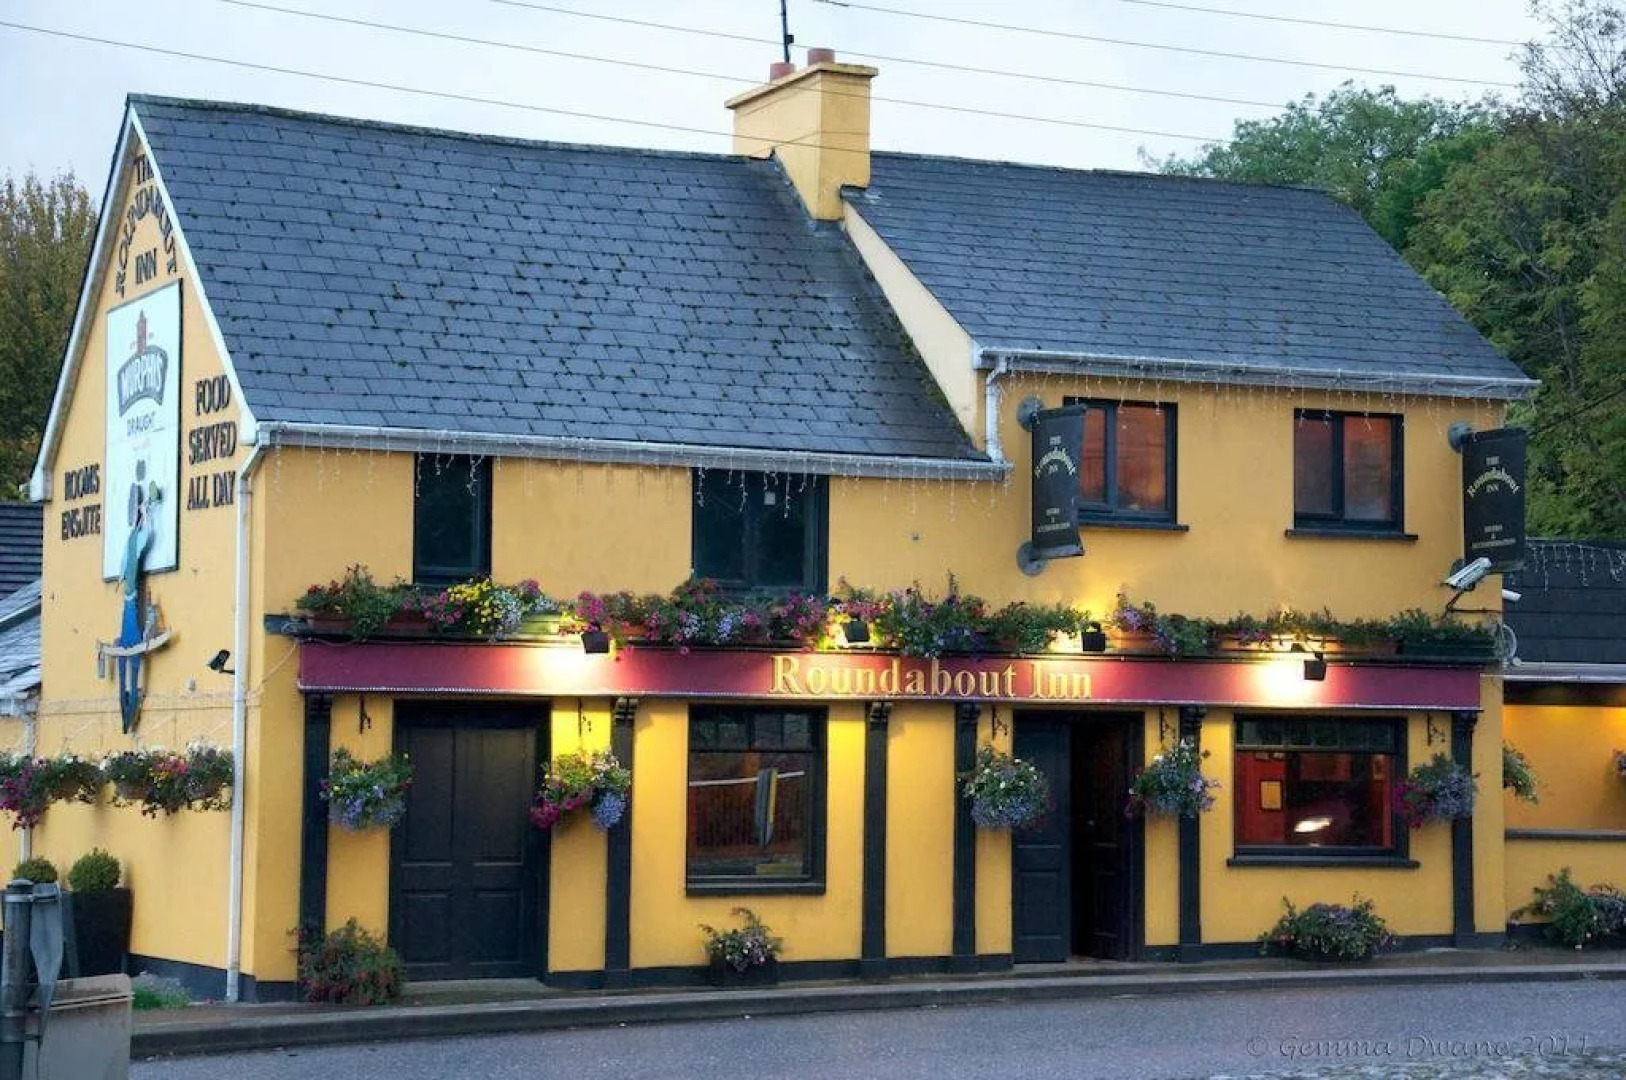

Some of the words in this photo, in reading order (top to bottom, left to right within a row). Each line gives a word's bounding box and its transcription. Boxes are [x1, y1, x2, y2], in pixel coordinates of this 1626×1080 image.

[134, 154, 154, 185] TH
[135, 248, 158, 285] INN
[195, 374, 231, 417] FOOD
[188, 420, 237, 466] SERVED
[64, 463, 101, 502] ROOMS
[187, 474, 210, 511] ALL
[212, 470, 237, 508] DAY
[768, 654, 1018, 698] Roundabout
[1028, 660, 1095, 700] Inn
